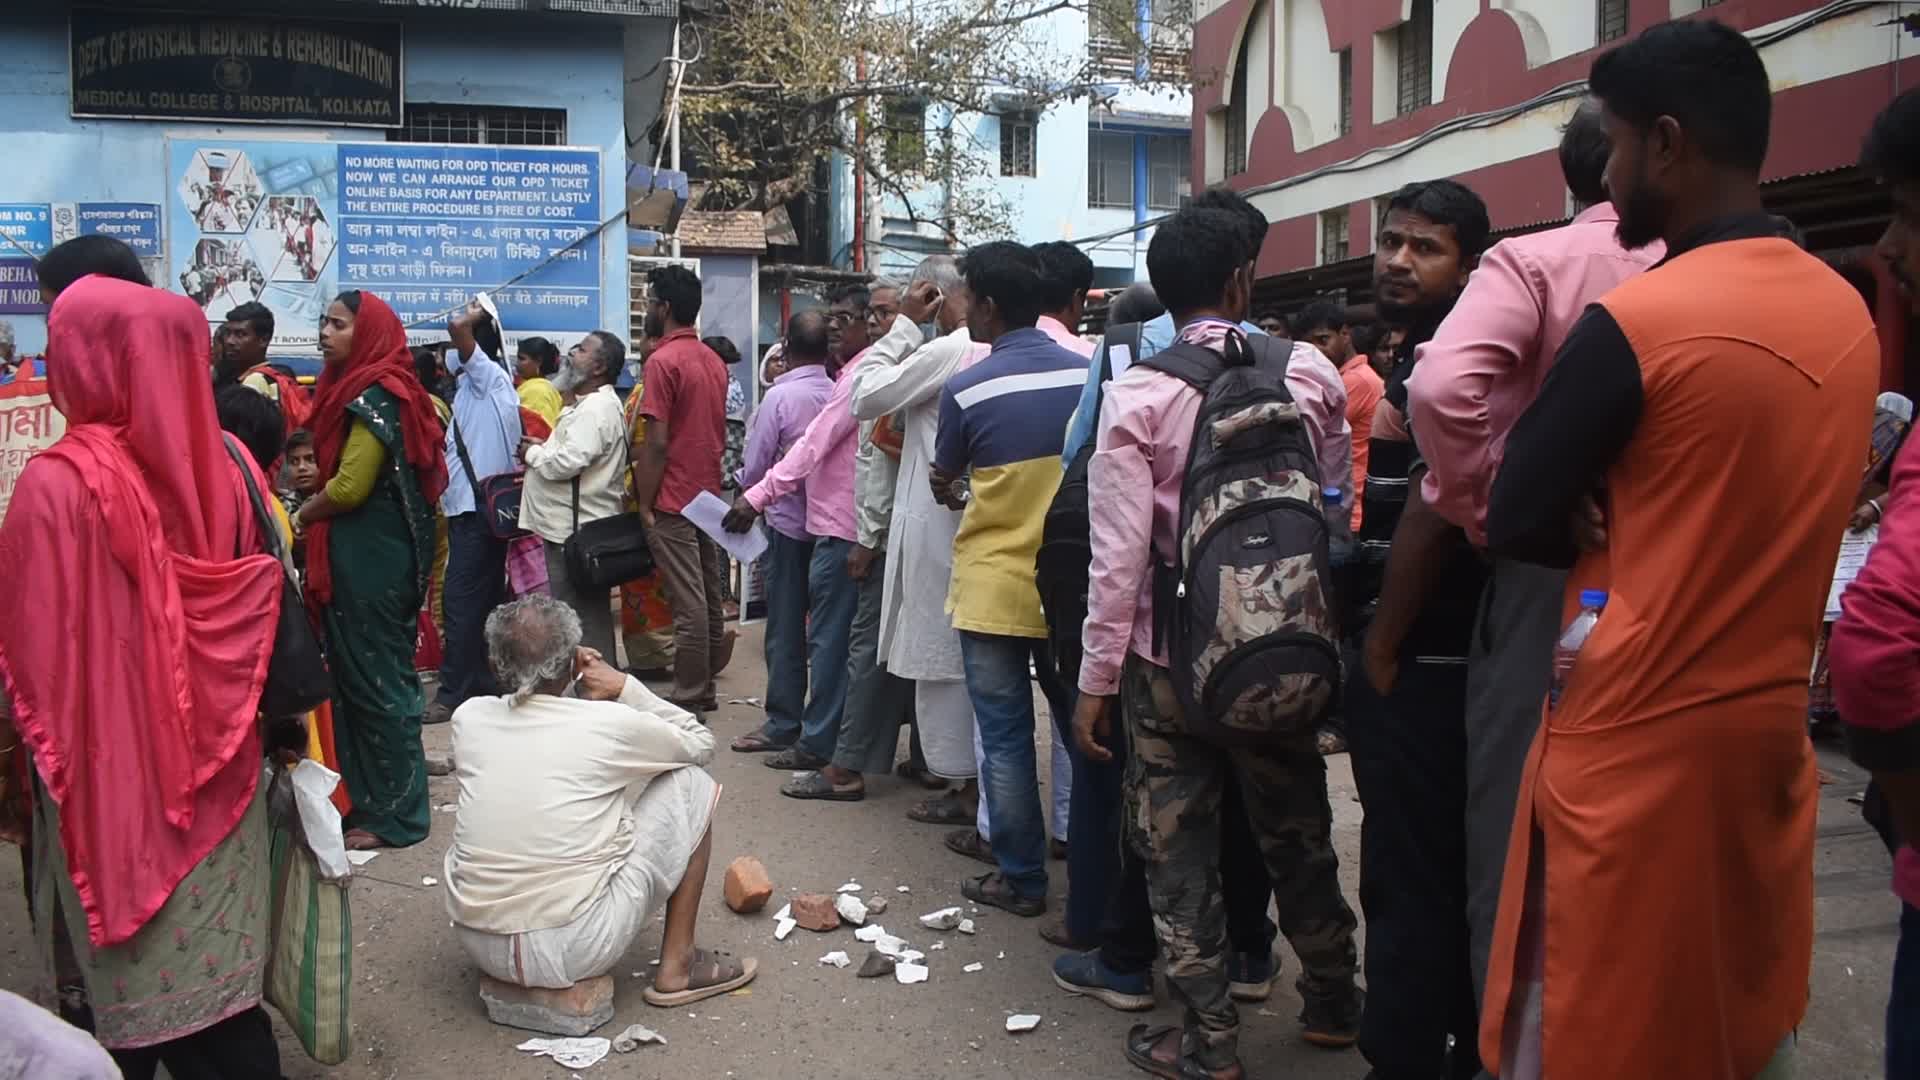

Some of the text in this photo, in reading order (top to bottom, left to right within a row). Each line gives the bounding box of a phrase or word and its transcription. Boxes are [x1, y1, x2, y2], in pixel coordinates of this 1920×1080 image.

[78, 24, 392, 89] DEPT. OF PHYSICAL MEDICINE & REHABILLITATION
[77, 89, 392, 116] MEDICAL COLLEGE & HOSPITAL, KOLKATA
[345, 156, 591, 175] NO MORE WAITING FOR OPD TICKET FOR HOURS.
[345, 171, 590, 189] NOW WE CAN ARRANGE OUR OPD TICKET
[345, 186, 592, 204] ONLINE BASIS FOR ANY DEPARTMENT. LASTLY
[15, 211, 36, 221] NO.
[38, 211, 47, 221] 9
[346, 200, 576, 218] THE ENTIRE PROCEDURE IS FREE OF COST.
[424, 223, 457, 240] লাইন
[489, 225, 521, 240] এবার
[523, 227, 550, 241] ঘরে
[506, 242, 541, 260] টিকিট
